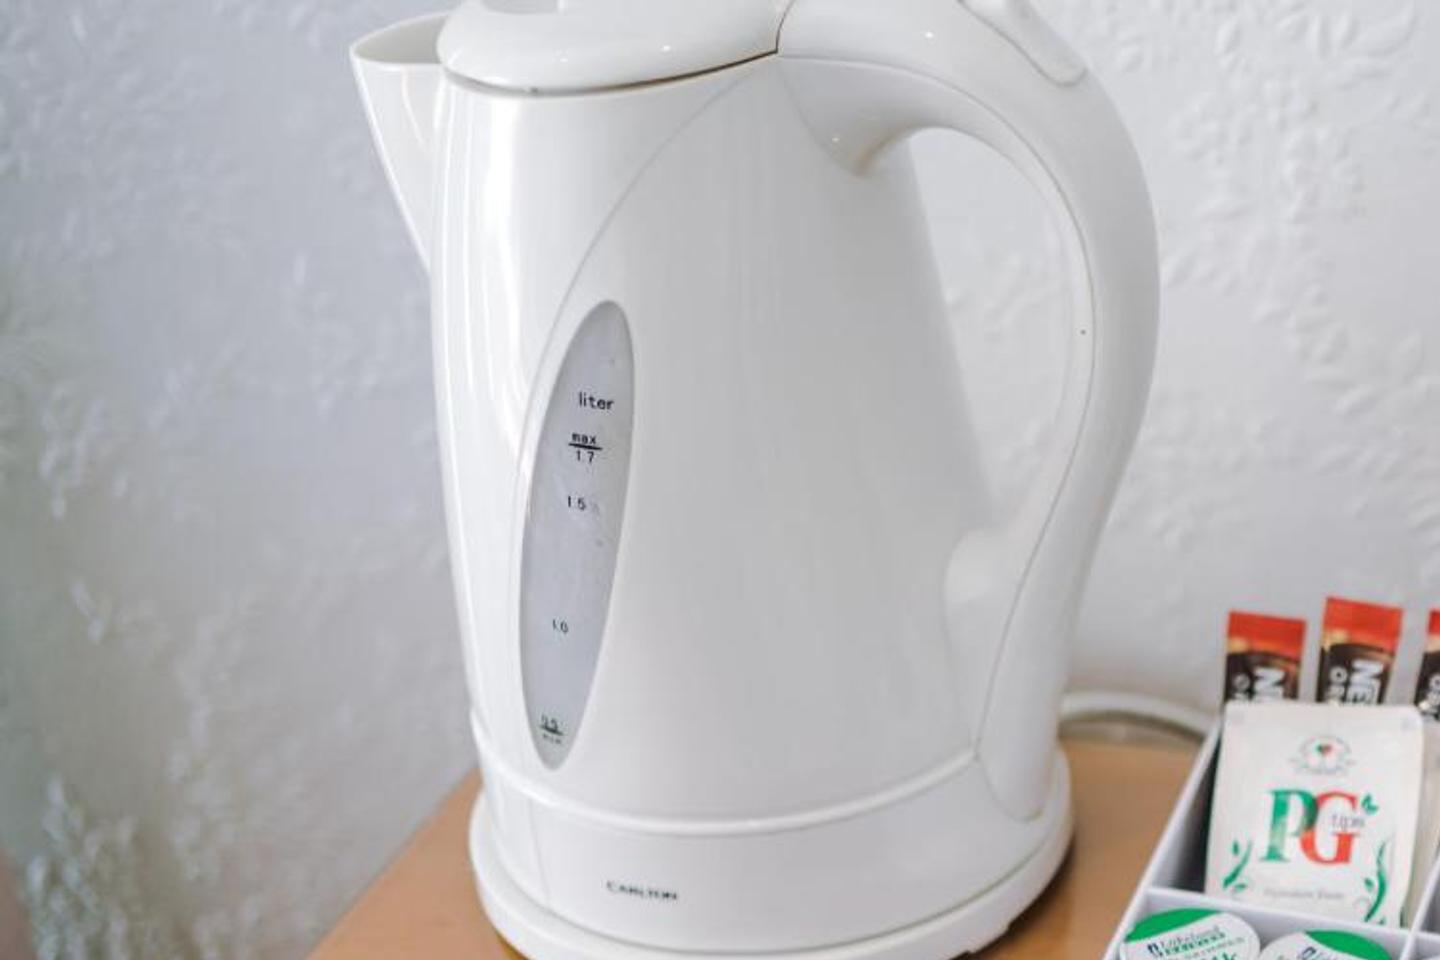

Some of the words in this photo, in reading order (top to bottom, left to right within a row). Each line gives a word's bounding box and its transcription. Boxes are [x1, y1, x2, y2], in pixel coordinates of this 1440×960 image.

[578, 391, 615, 410] liter
[572, 432, 597, 444] max
[1260, 789, 1357, 865] PG
